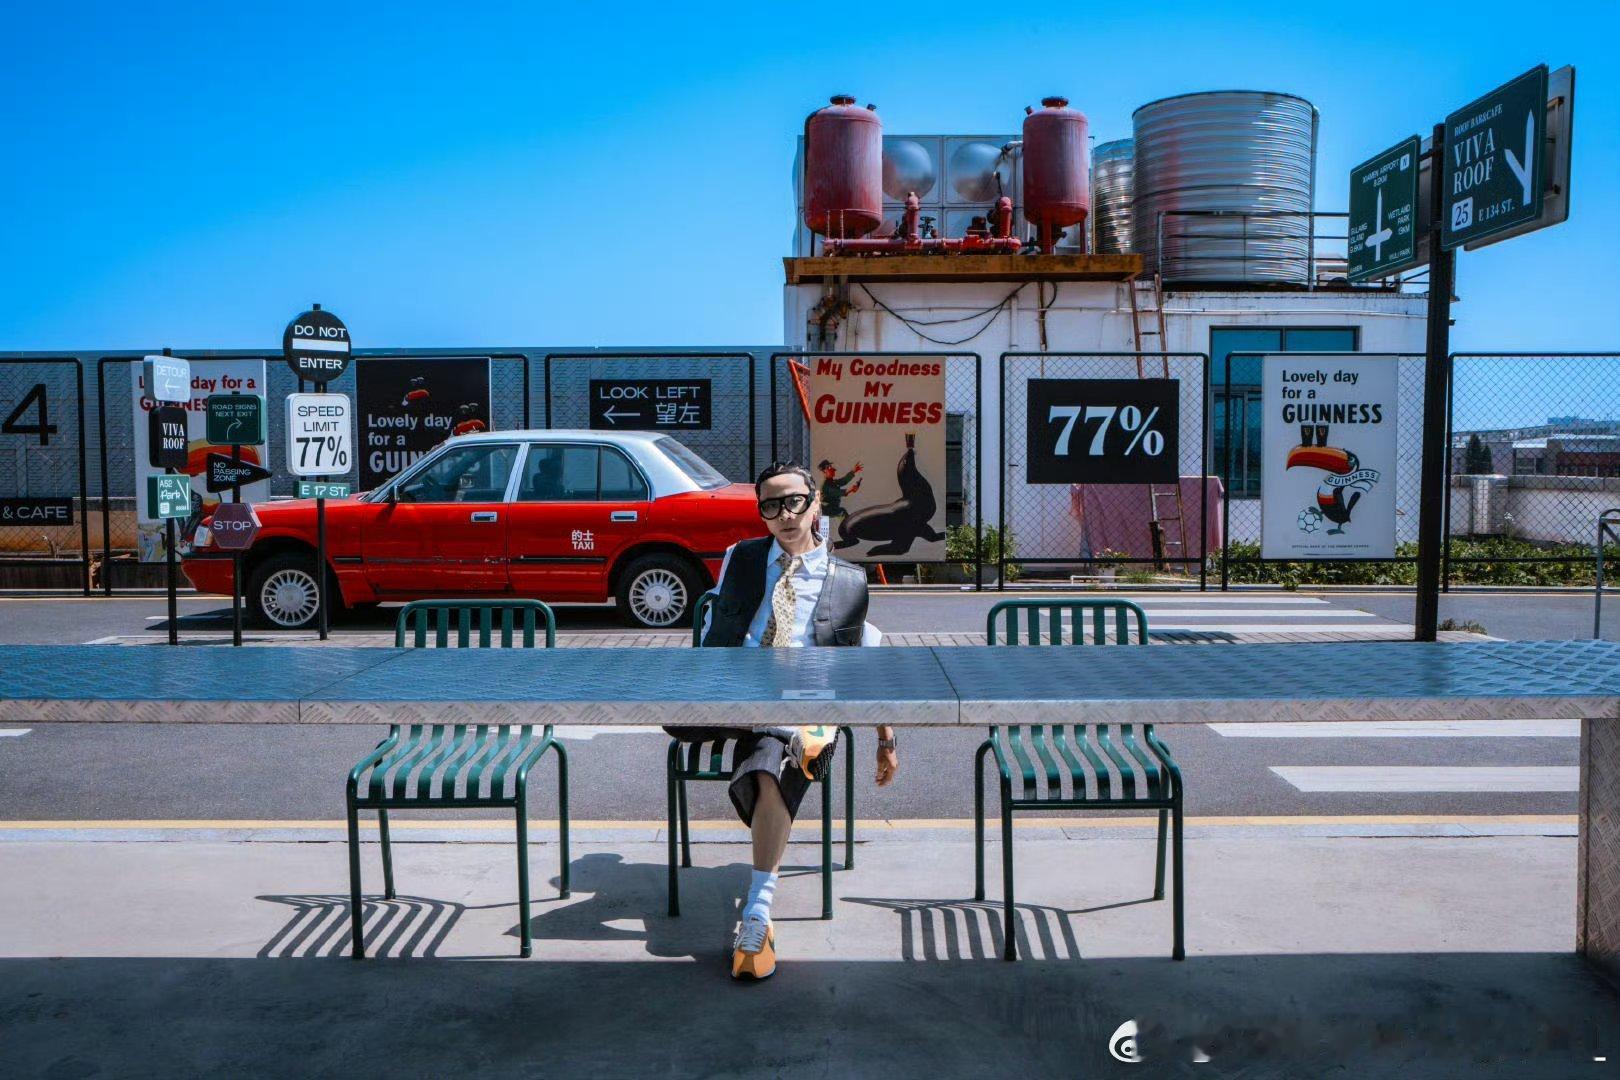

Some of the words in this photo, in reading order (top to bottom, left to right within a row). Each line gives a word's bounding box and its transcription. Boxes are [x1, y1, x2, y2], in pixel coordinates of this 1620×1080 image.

[1454, 127, 1495, 168] VIVA
[1380, 158, 1400, 174] AIRPORT
[1453, 156, 1494, 195] ROOF
[1455, 203, 1469, 226] 25
[1478, 208, 1484, 222] E
[1486, 202, 1500, 220] 134
[1501, 198, 1515, 214] ST.
[1397, 214, 1410, 225] PARK
[294, 324, 314, 336] DO
[319, 326, 347, 339] NOT
[300, 357, 343, 370] ENTER
[817, 358, 842, 379] My
[849, 358, 941, 377] Goodness
[156, 364, 187, 378] DETOUR
[1282, 370, 1328, 385] Lovely
[1333, 370, 1359, 385] day
[190, 375, 217, 393] day
[222, 375, 243, 389] for
[246, 378, 256, 389] a
[864, 380, 894, 398] MY
[600, 386, 648, 399] LOOK
[656, 386, 701, 399] LEFT
[1282, 386, 1303, 400] for
[1306, 389, 1316, 400] a
[2, 383, 58, 446] 4
[297, 405, 345, 417] SPEED
[655, 402, 701, 425] 望左
[814, 394, 943, 425] GUINNESS
[1282, 403, 1383, 424] GUINNESS
[303, 420, 340, 432] LIMIT
[368, 413, 418, 430] Lovely
[424, 413, 453, 430] day
[162, 422, 185, 437] VIVA
[1048, 405, 1165, 456] 77%
[162, 437, 185, 450] ROOF
[368, 432, 390, 446] for
[396, 434, 406, 446] a
[296, 435, 347, 467] 77%
[213, 461, 226, 469] NO
[213, 468, 252, 477] PASSING
[1327, 471, 1376, 485] GUINNESS
[160, 479, 173, 488] A52
[160, 489, 181, 501] Park
[301, 486, 309, 496] E
[314, 486, 326, 497] 17
[329, 486, 349, 498] ST.
[2, 506, 14, 520] &
[16, 506, 68, 519] CAFE
[213, 520, 251, 532] STOP
[571, 530, 594, 541] 的士
[571, 541, 594, 551] TAXI
